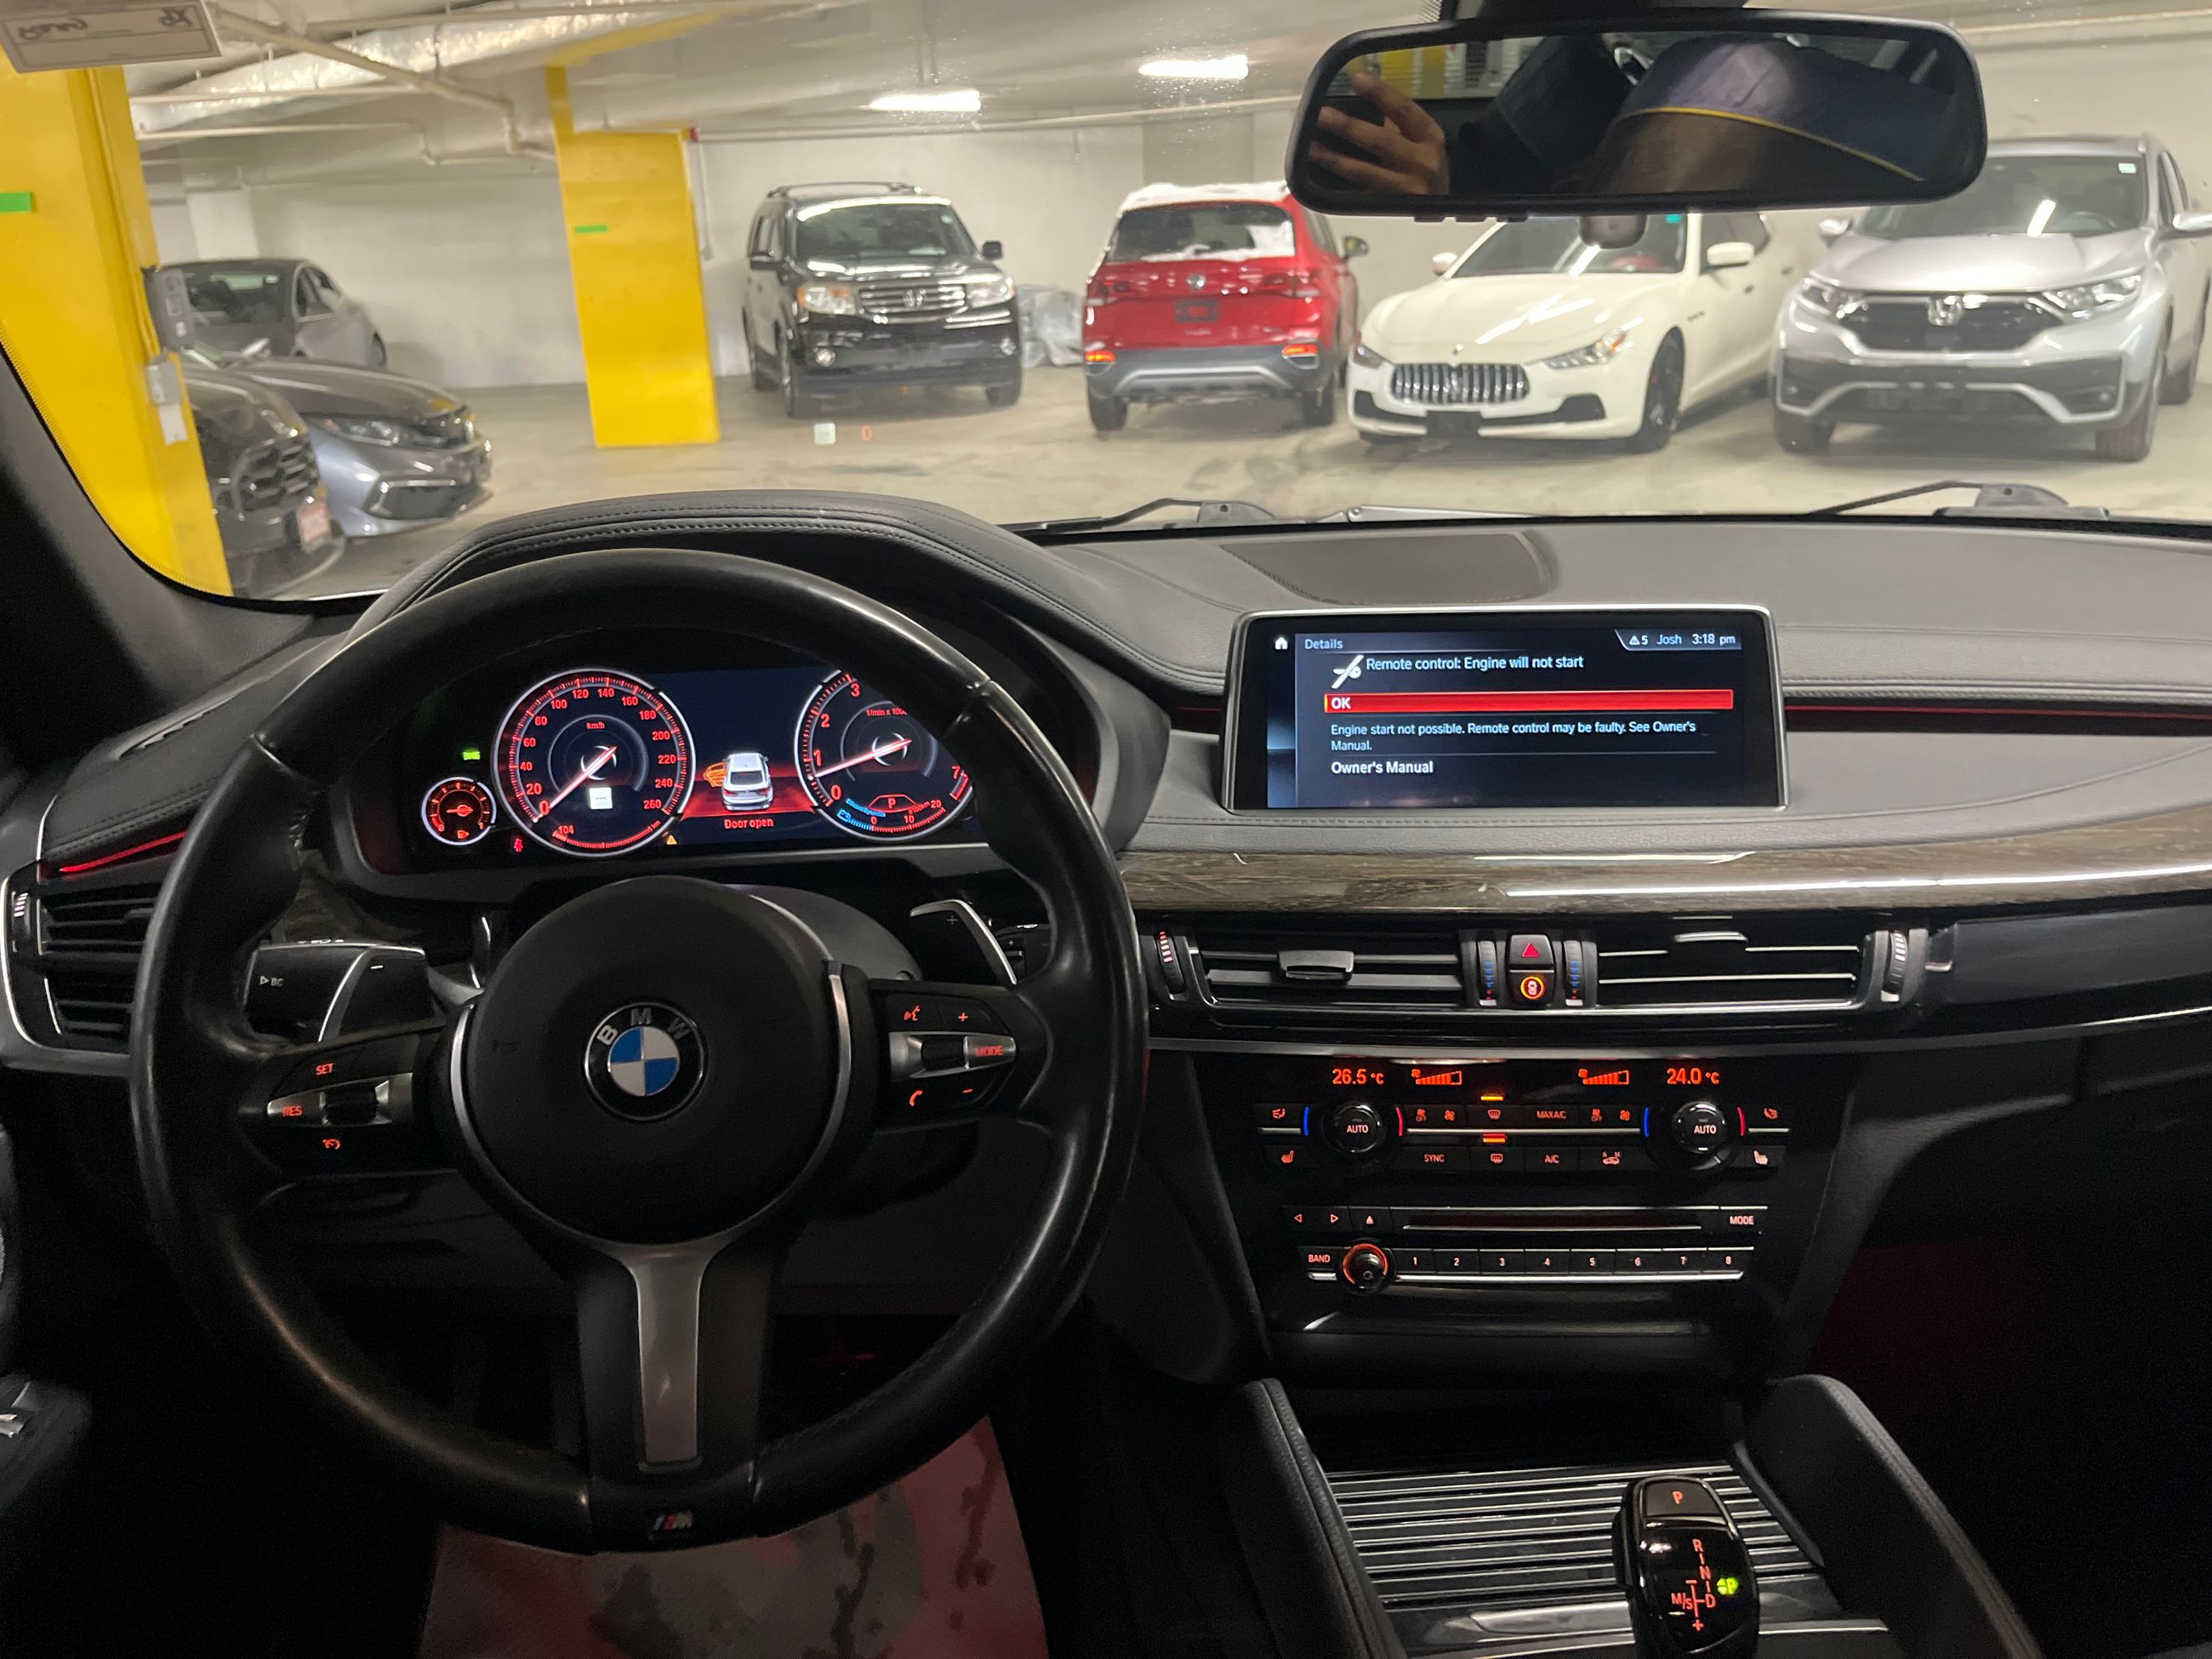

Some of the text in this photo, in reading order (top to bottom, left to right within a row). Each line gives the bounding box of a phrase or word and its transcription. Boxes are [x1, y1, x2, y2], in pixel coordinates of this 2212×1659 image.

[1303, 637, 1343, 650] Details
[1641, 634, 1736, 647] 5 Josh 3:18 pm
[1365, 655, 1584, 671] Remote control: Engine will not start
[573, 688, 589, 699] 120
[597, 687, 614, 698] 140
[850, 683, 860, 697] 3
[550, 699, 567, 710] 100
[621, 696, 639, 706] 160
[1331, 698, 1351, 710] OK
[640, 710, 656, 720] 180
[534, 715, 548, 727] 80
[586, 721, 605, 730] km/h
[820, 714, 830, 727] 2
[1331, 721, 1696, 737] Engine start not possible. Remote control may be faulty. See Owner's
[652, 730, 670, 740] 200
[523, 737, 536, 747] 60
[1331, 739, 1373, 752] Manual.
[658, 754, 676, 764] 220
[813, 750, 822, 766] 1
[520, 761, 533, 771] 40
[1331, 760, 1434, 774] Owner's Manual
[952, 766, 960, 779] 7
[655, 778, 673, 788] 240
[526, 783, 542, 795] 20
[831, 784, 842, 801] 0
[539, 800, 550, 815] 0
[643, 800, 661, 809] 260
[888, 799, 896, 809] P
[931, 800, 942, 808] 20
[724, 818, 773, 830] Door open
[871, 817, 877, 825] 0
[904, 815, 914, 824] 10
[559, 825, 574, 835] 104
[271, 978, 284, 987] BC
[596, 1007, 689, 1046] BMW
[975, 1045, 1003, 1057] MODE
[316, 1063, 334, 1075] SET
[1332, 1069, 1367, 1086] 26.5
[1667, 1067, 1701, 1085] 24.0
[1346, 1124, 1368, 1134] AUTO
[1693, 1125, 1716, 1134] AUTO
[1424, 1154, 1444, 1163] SYNC
[1544, 1154, 1559, 1164] A/C
[1730, 1216, 1753, 1225] MODE
[1308, 1254, 1331, 1263] BAND
[1453, 1257, 1460, 1267] 2
[1499, 1257, 1505, 1267] 3
[1544, 1257, 1551, 1266] 4
[1589, 1257, 1596, 1266] 5
[1634, 1257, 1641, 1266] 6
[1680, 1257, 1687, 1265] 7
[1725, 1256, 1731, 1265] 8
[1673, 1491, 1684, 1503] P
[1692, 1539, 1704, 1552] R
[1700, 1566, 1711, 1580] N
[1706, 1594, 1716, 1607] D
